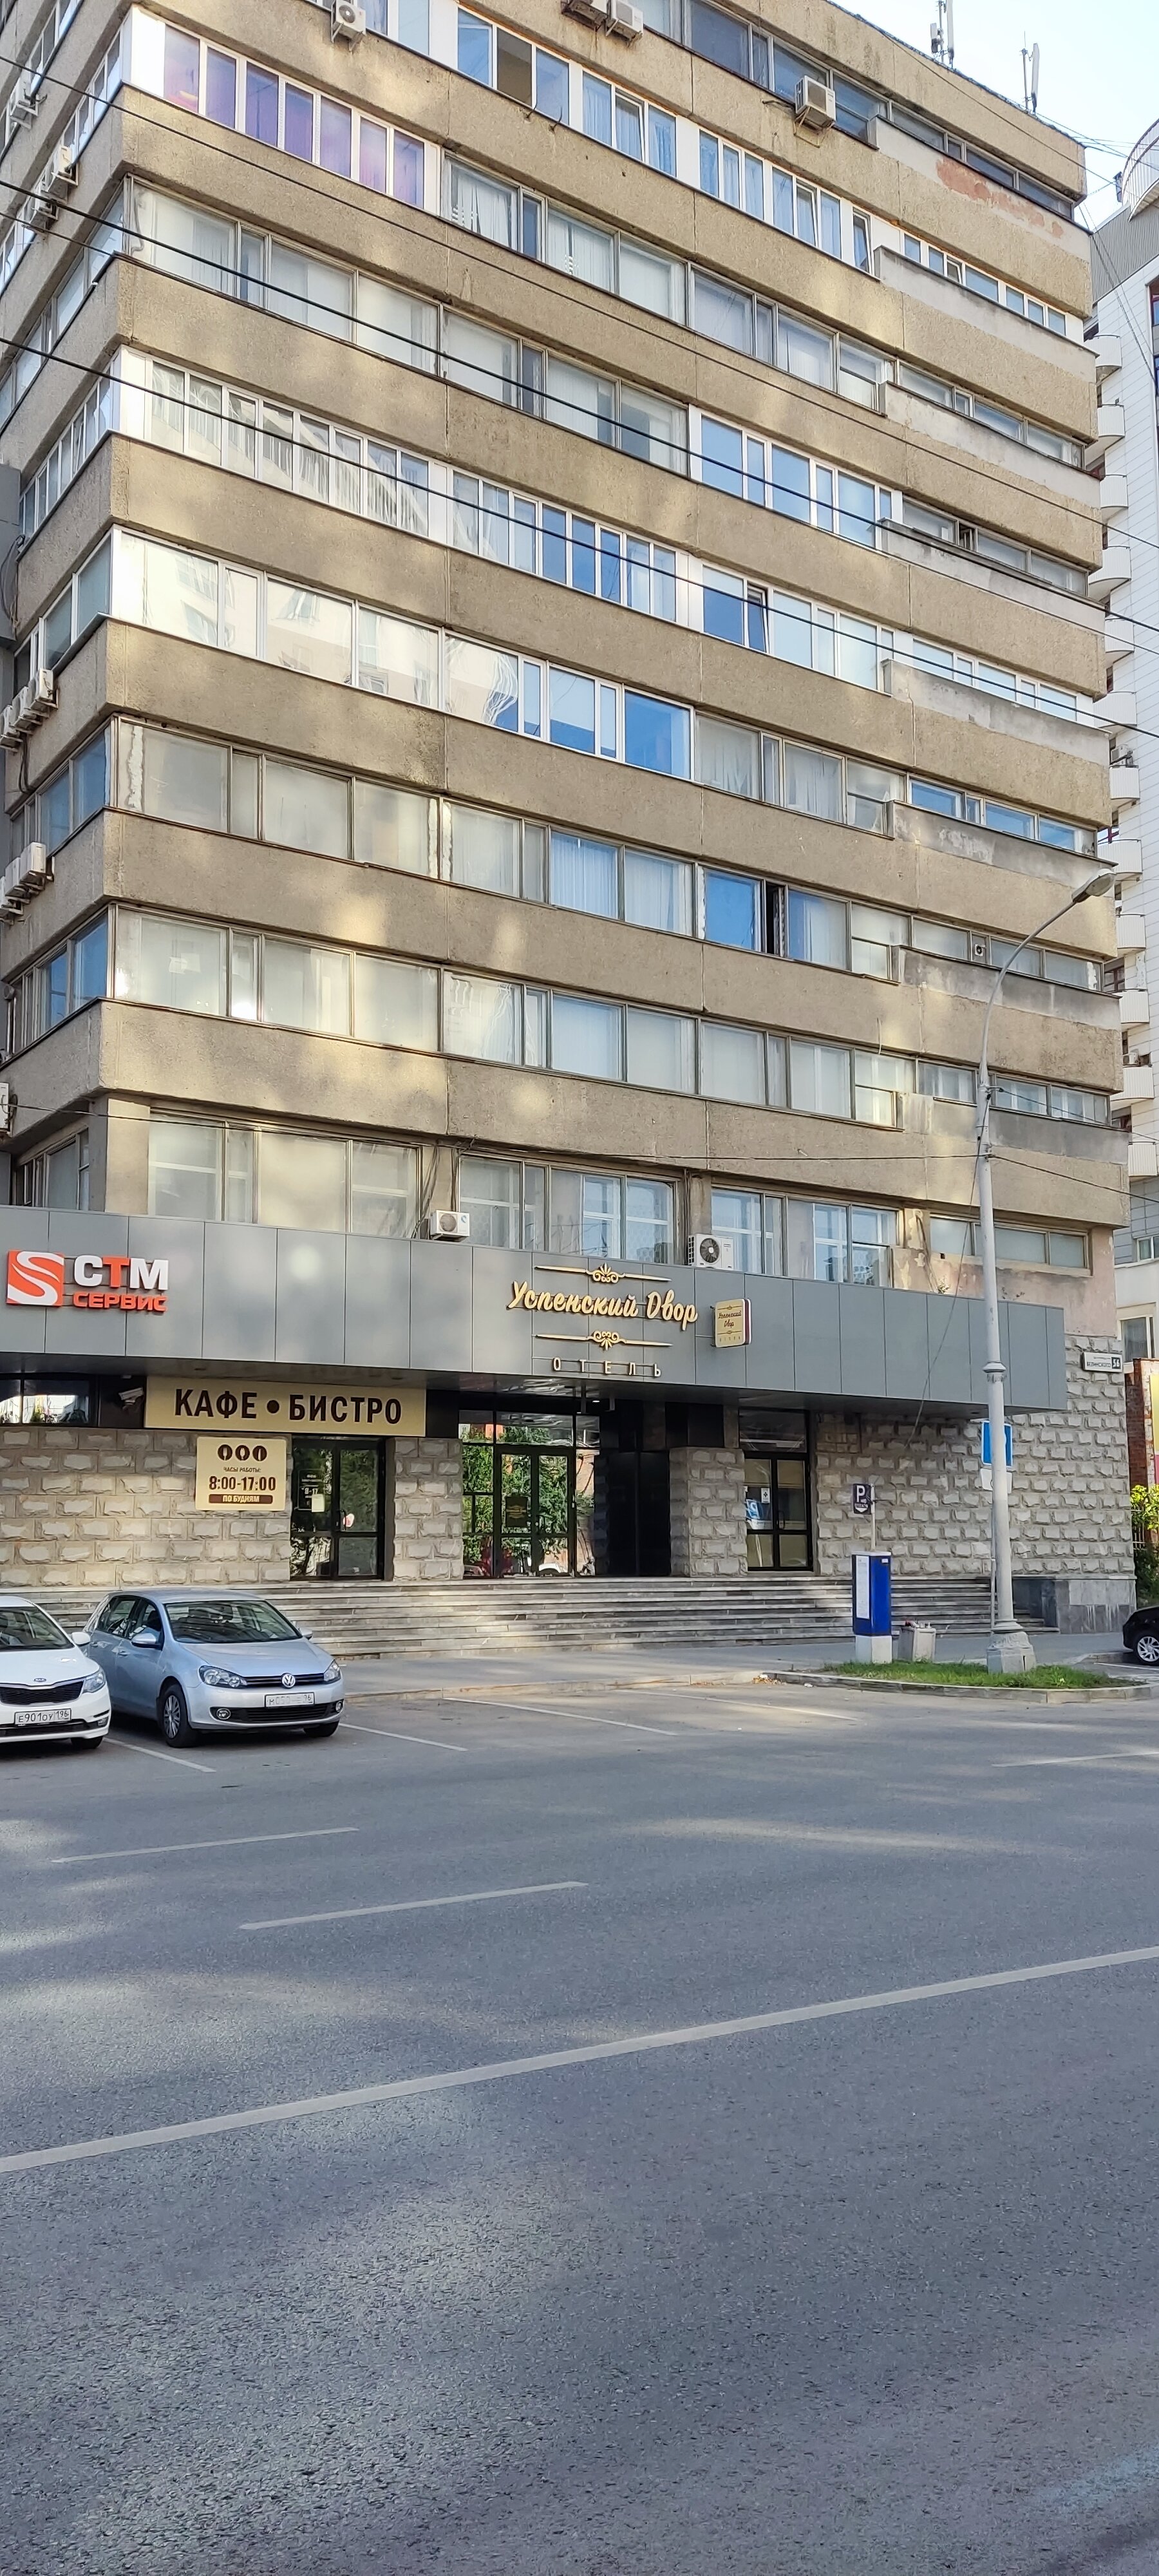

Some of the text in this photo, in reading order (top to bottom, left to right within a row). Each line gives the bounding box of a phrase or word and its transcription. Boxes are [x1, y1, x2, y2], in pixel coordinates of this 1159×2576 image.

[74, 1255, 169, 1291] СТМ
[73, 1291, 168, 1312] СЕРВИС
[507, 1281, 699, 1331] Успенский Двор
[553, 1357, 662, 1378] ОТЕЛЬ
[174, 1388, 402, 1425] КАФЕ БИСТРО
[209, 1475, 276, 1491] 8:00-17:00
[232, 1495, 260, 1503] БУДНЯМ
